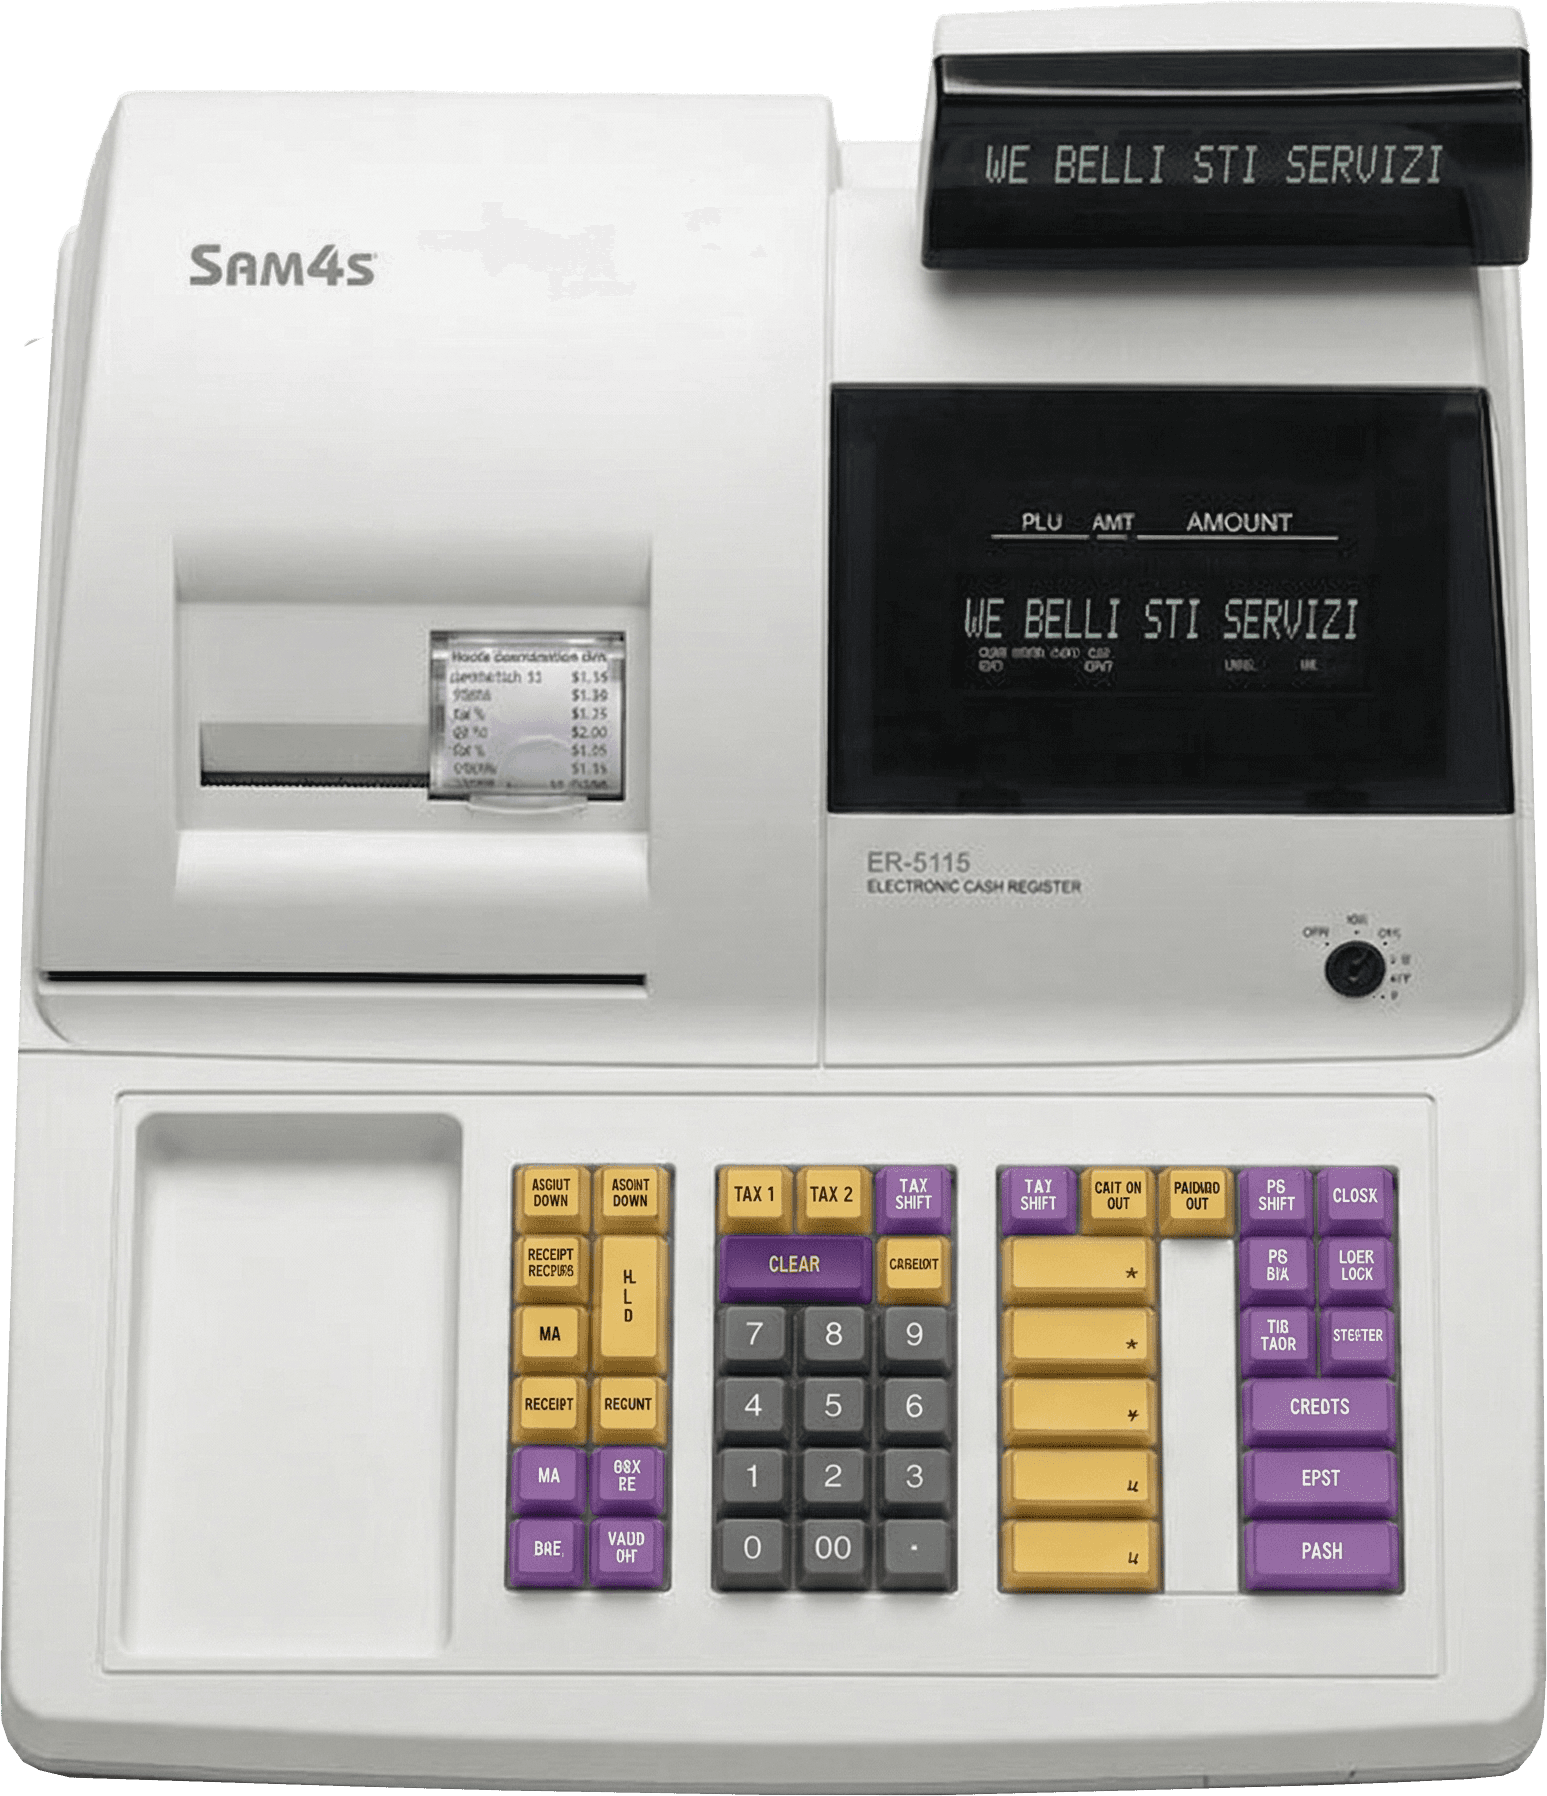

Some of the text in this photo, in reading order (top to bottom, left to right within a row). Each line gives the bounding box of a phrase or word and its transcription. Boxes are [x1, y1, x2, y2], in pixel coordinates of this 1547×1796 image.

[985, 144, 1443, 184] WE BELLI STI SERVIZI
[1021, 512, 1063, 532] PLU
[1092, 512, 1135, 532] AMT
[1186, 512, 1293, 532] AMOUNT
[965, 598, 1358, 640] WE BELLI STI SERVIZI
[572, 726, 608, 739] $2.00
[868, 851, 971, 873] ER-5115
[867, 879, 1081, 893] ELECTRONIC CASH REGISTER
[734, 1186, 774, 1202] TAX 1
[810, 1186, 853, 1202] TAX 2
[899, 1178, 928, 1193] TAX
[1024, 1179, 1053, 1194] TAY
[1095, 1181, 1142, 1194] CAIT ON
[533, 1194, 568, 1207] DOWN
[613, 1194, 648, 1207] DOWN
[895, 1195, 932, 1210] SHIFT
[1020, 1196, 1057, 1210] SHIFT
[1107, 1197, 1130, 1210] OUT
[1186, 1197, 1209, 1210] OUT
[1258, 1196, 1295, 1211] SHIFT
[528, 1248, 574, 1261] RECEIPT
[1339, 1250, 1375, 1264] LOER
[769, 1255, 820, 1273] CLEAR
[1341, 1267, 1373, 1281] LOCK
[540, 1326, 561, 1341] MA
[746, 1322, 764, 1345] 7
[825, 1322, 843, 1346] 8
[906, 1322, 924, 1346] 9
[1261, 1337, 1296, 1351] TAOR
[525, 1397, 574, 1411] RECEIPT
[744, 1393, 762, 1416] 4
[825, 1393, 842, 1417] 5
[906, 1393, 923, 1417] 6
[1290, 1398, 1350, 1416] CREDTS
[538, 1467, 560, 1483] MA
[747, 1464, 757, 1487] 1
[824, 1464, 842, 1487] 2
[906, 1464, 923, 1488] 3
[1302, 1469, 1341, 1487] EPST
[744, 1535, 762, 1559] 0
[815, 1535, 851, 1559] 00
[1302, 1542, 1343, 1560] PASH
